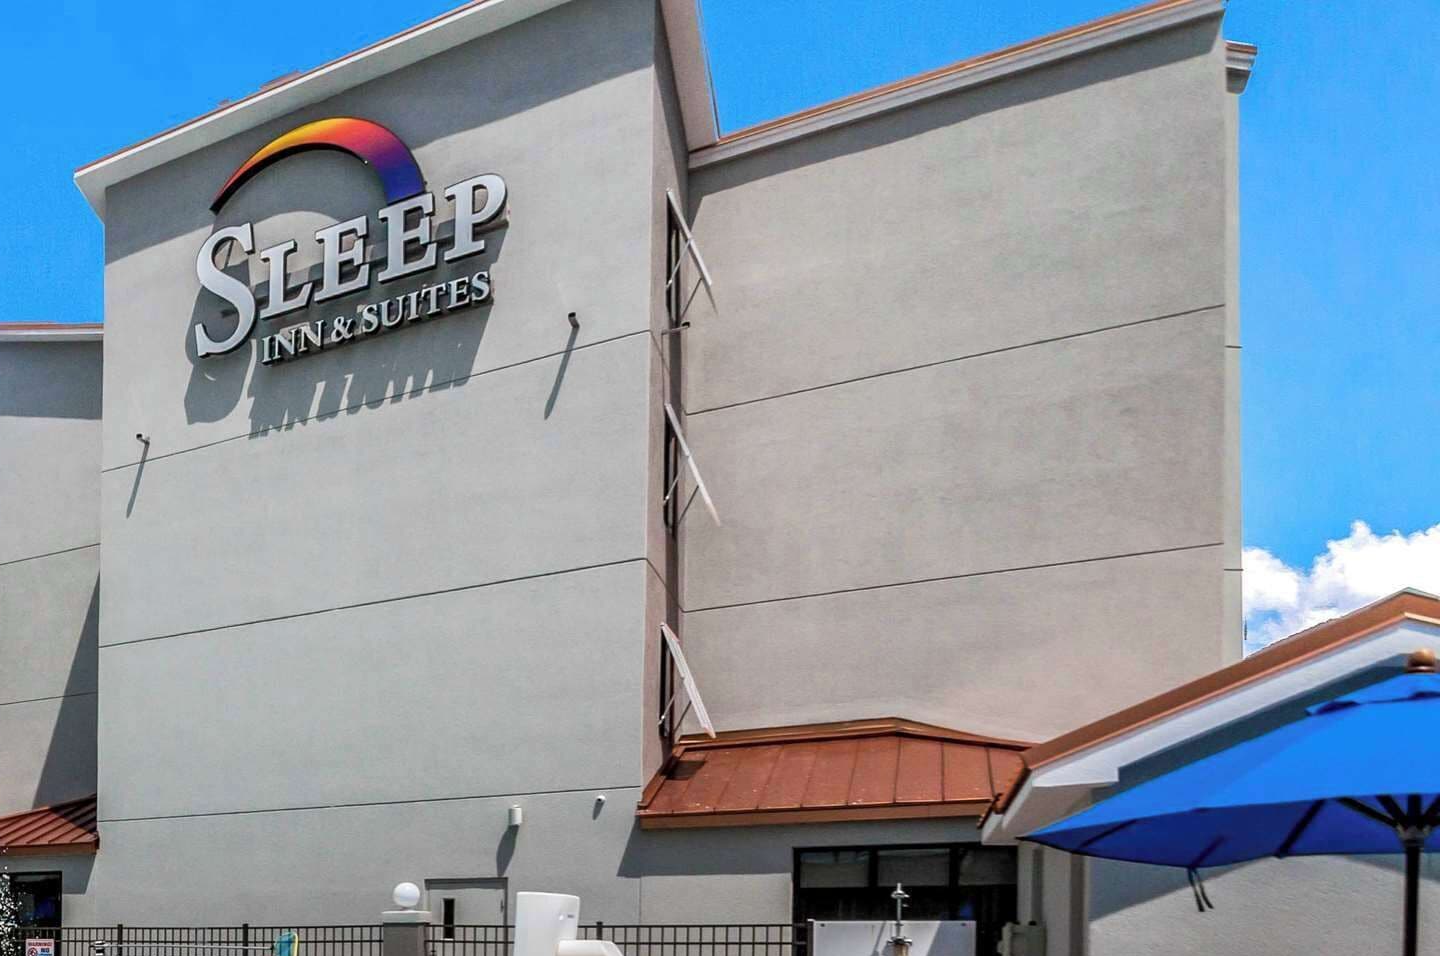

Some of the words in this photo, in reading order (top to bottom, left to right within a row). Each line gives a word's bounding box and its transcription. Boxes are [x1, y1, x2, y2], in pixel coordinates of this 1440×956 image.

[195, 173, 507, 358] SLEEP
[261, 320, 323, 364] INN
[330, 316, 354, 345] &
[361, 270, 490, 334] SUITES
